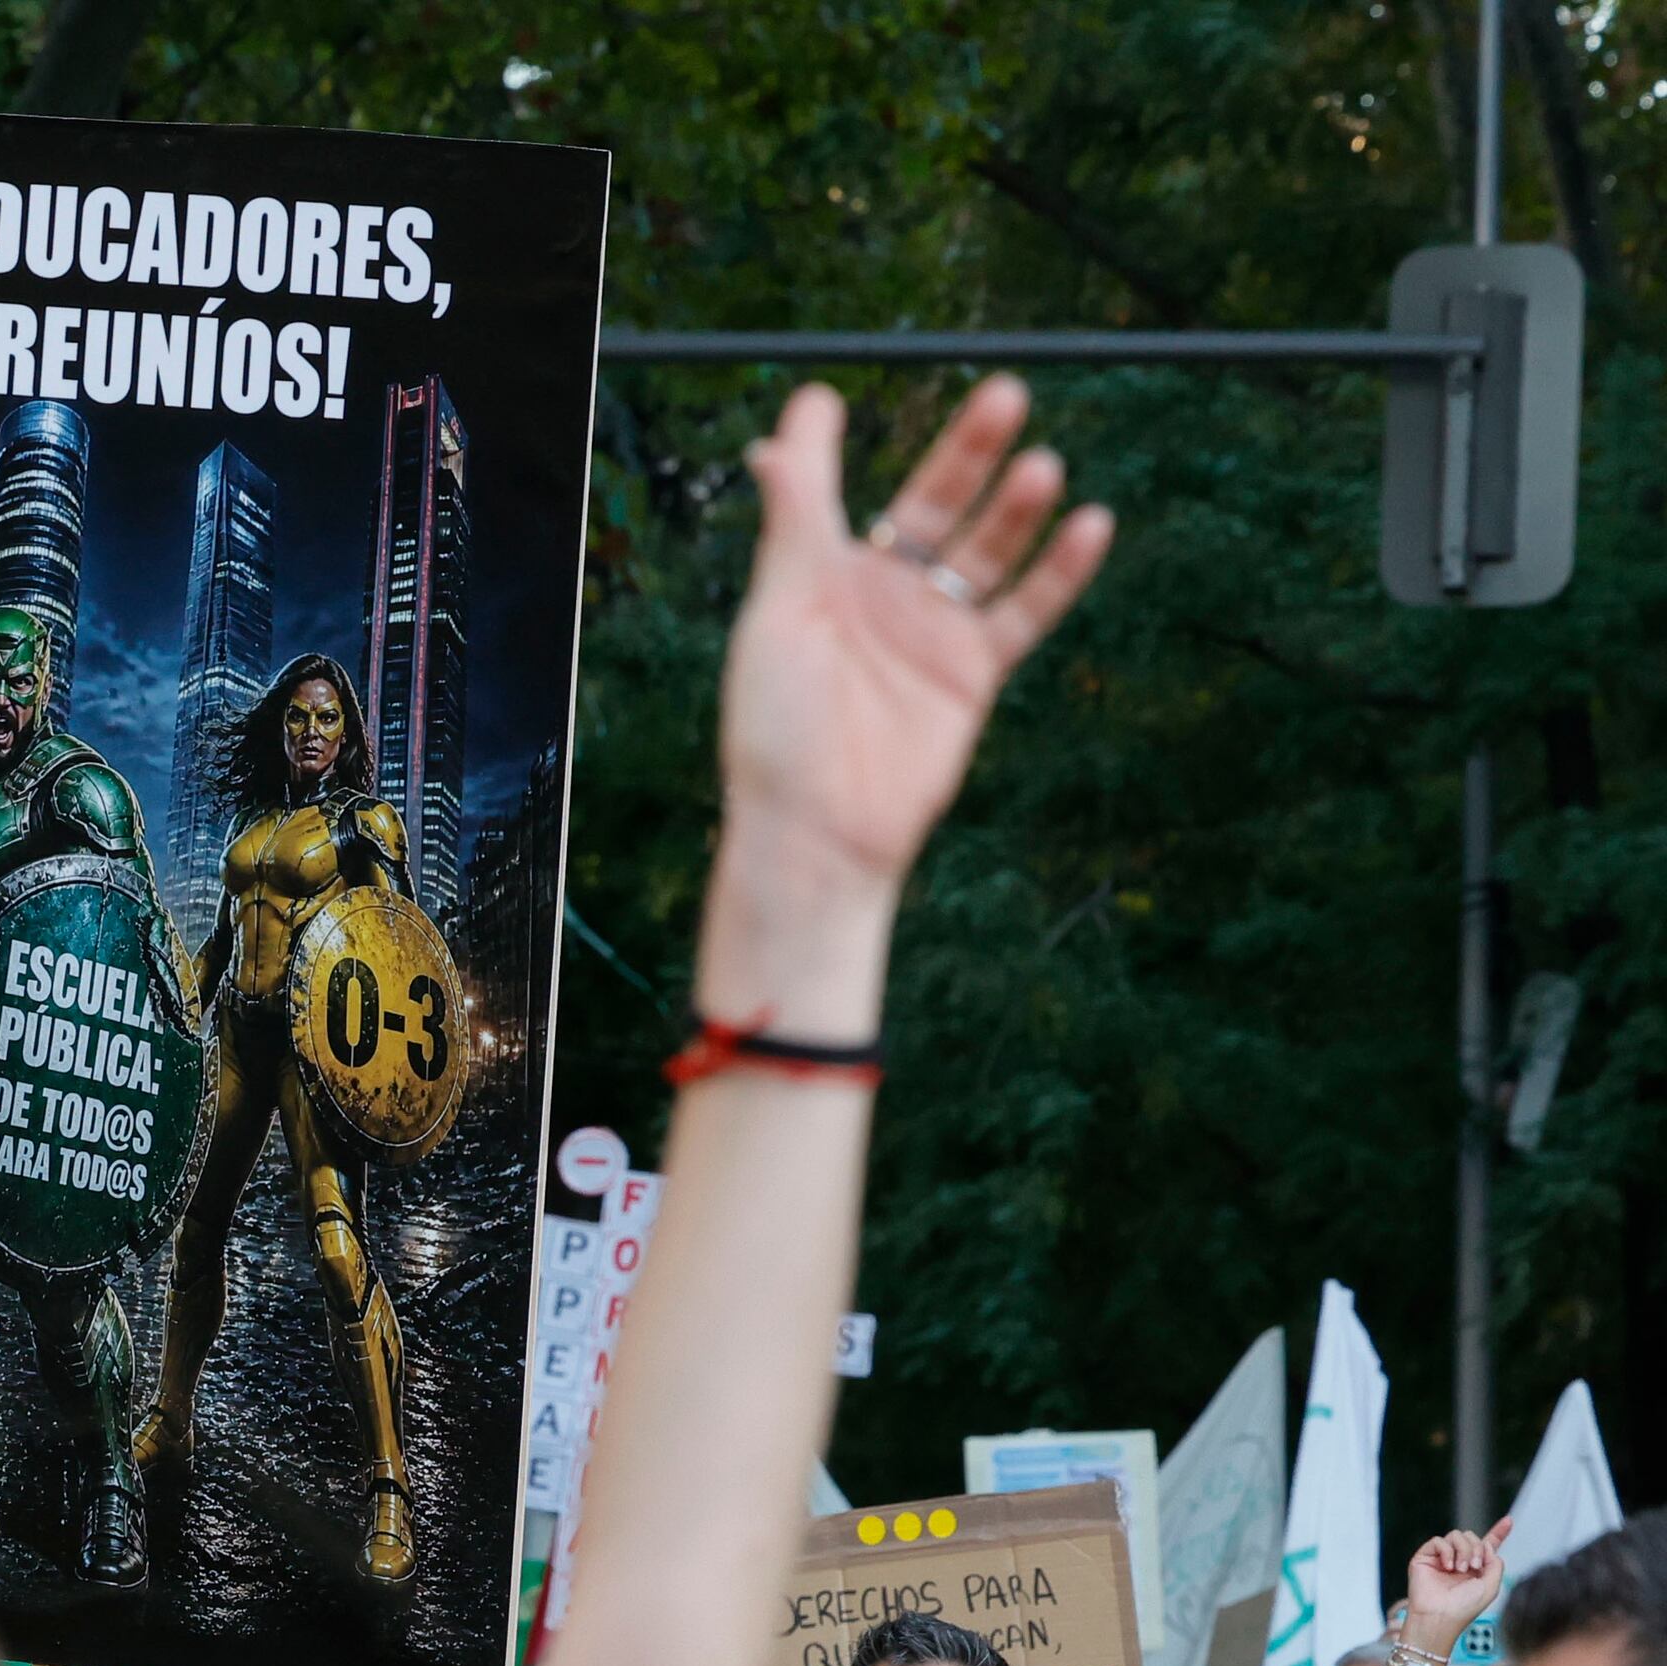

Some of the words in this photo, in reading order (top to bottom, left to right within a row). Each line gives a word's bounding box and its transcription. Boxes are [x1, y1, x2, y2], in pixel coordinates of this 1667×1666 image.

[326, 956, 449, 1082] 0-3
[41, 1086, 154, 1156] TOD@S
[58, 1146, 148, 1202] TOD@S
[963, 1567, 1058, 1613] PARA
